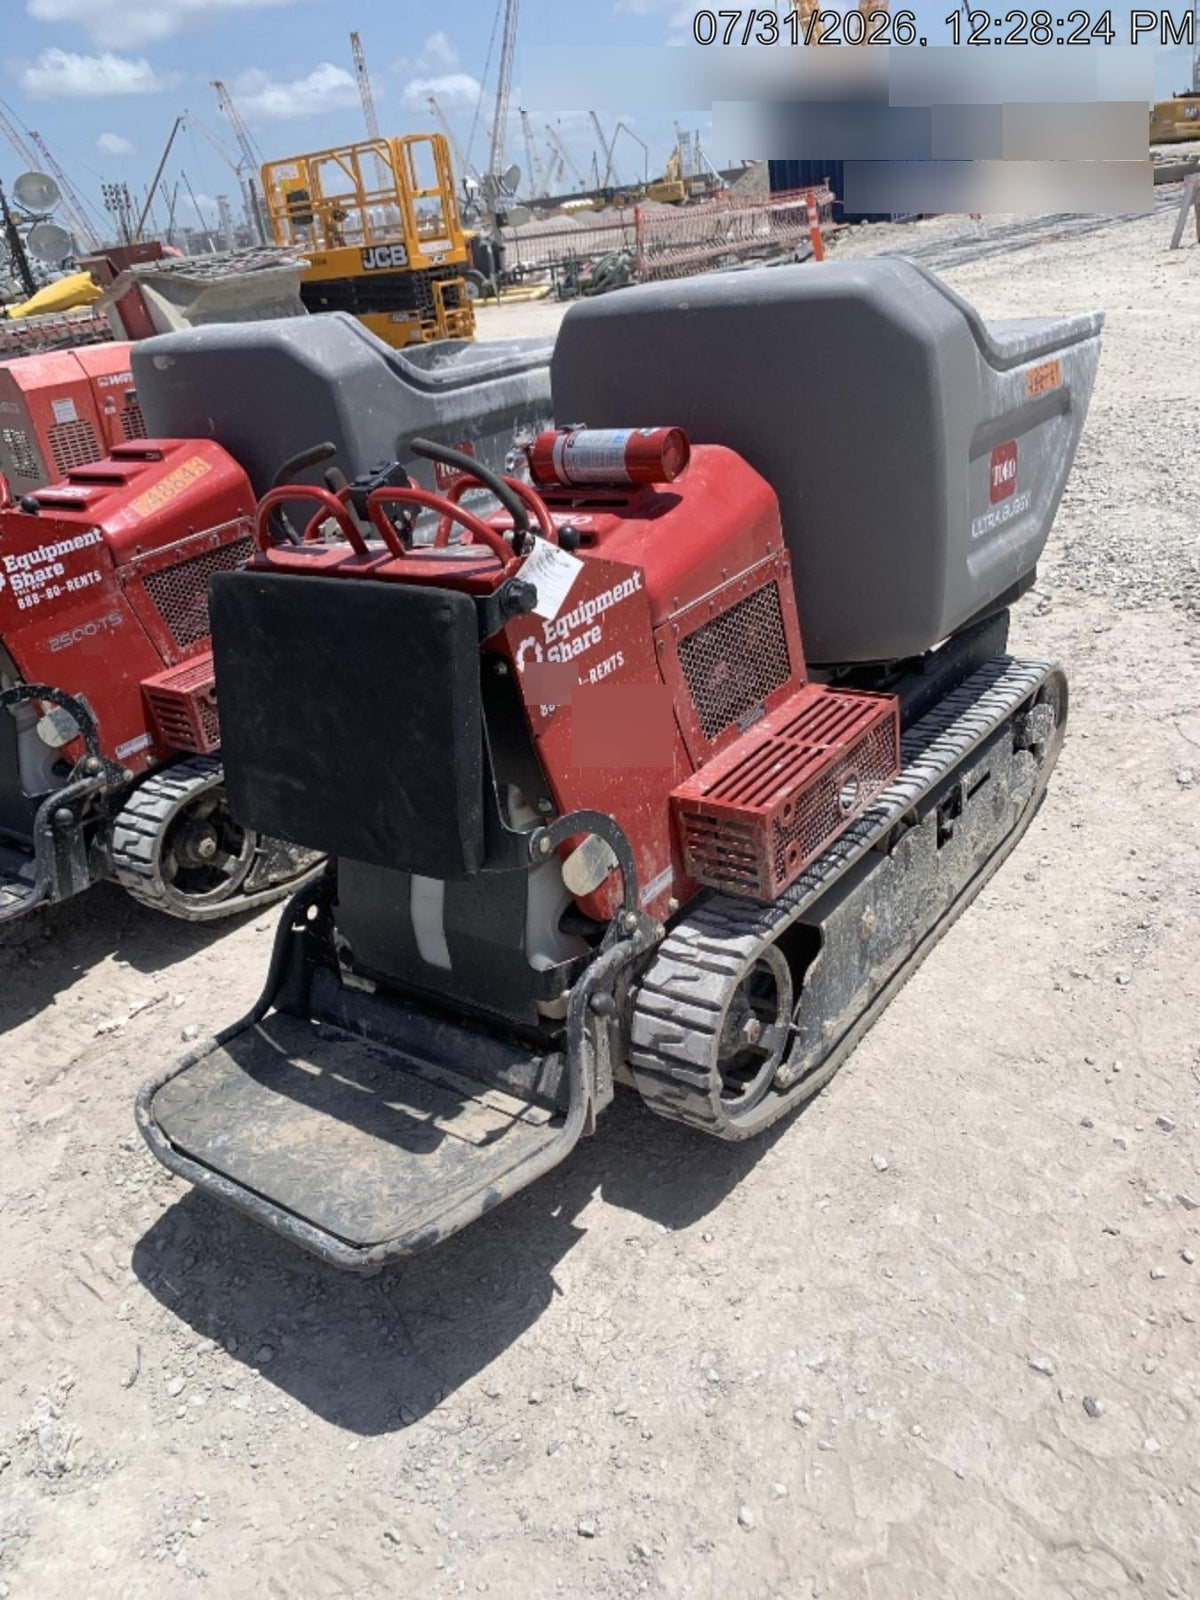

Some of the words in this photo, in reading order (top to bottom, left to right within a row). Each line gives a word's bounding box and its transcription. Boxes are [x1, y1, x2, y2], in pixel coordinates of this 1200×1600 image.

[363, 244, 407, 269] JCB
[3, 528, 103, 573] Equipment
[9, 563, 65, 591] Share
[17, 570, 102, 610] 888-80-RENTS
[542, 570, 642, 644] Equipment
[547, 625, 602, 662] Share
